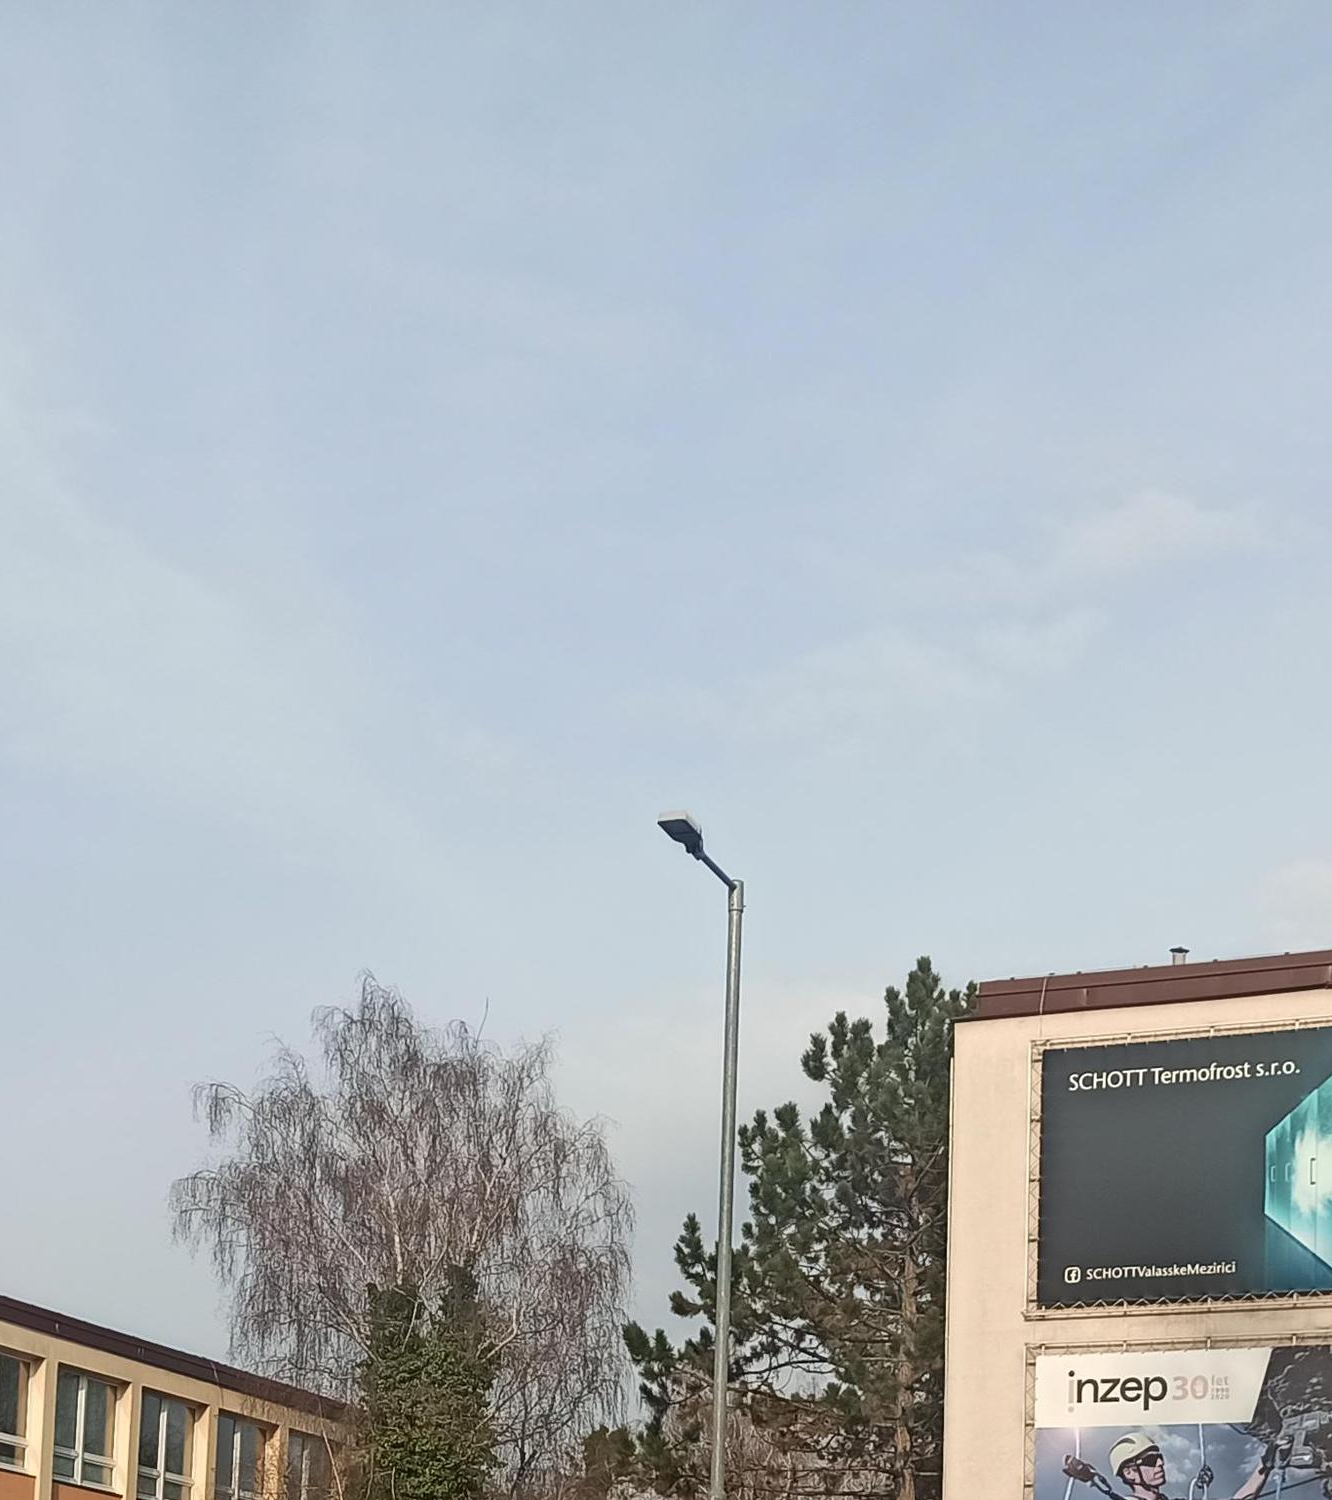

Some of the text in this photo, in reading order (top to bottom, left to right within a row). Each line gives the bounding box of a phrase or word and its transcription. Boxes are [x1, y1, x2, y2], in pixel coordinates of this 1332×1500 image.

[1068, 1060, 1301, 1091] SCHOTT Termofrost s.r.o.
[1086, 1261, 1236, 1280] SCHOTTValasskeMezirici
[1068, 1370, 1168, 1411] inzep
[1172, 1375, 1209, 1401] 30
